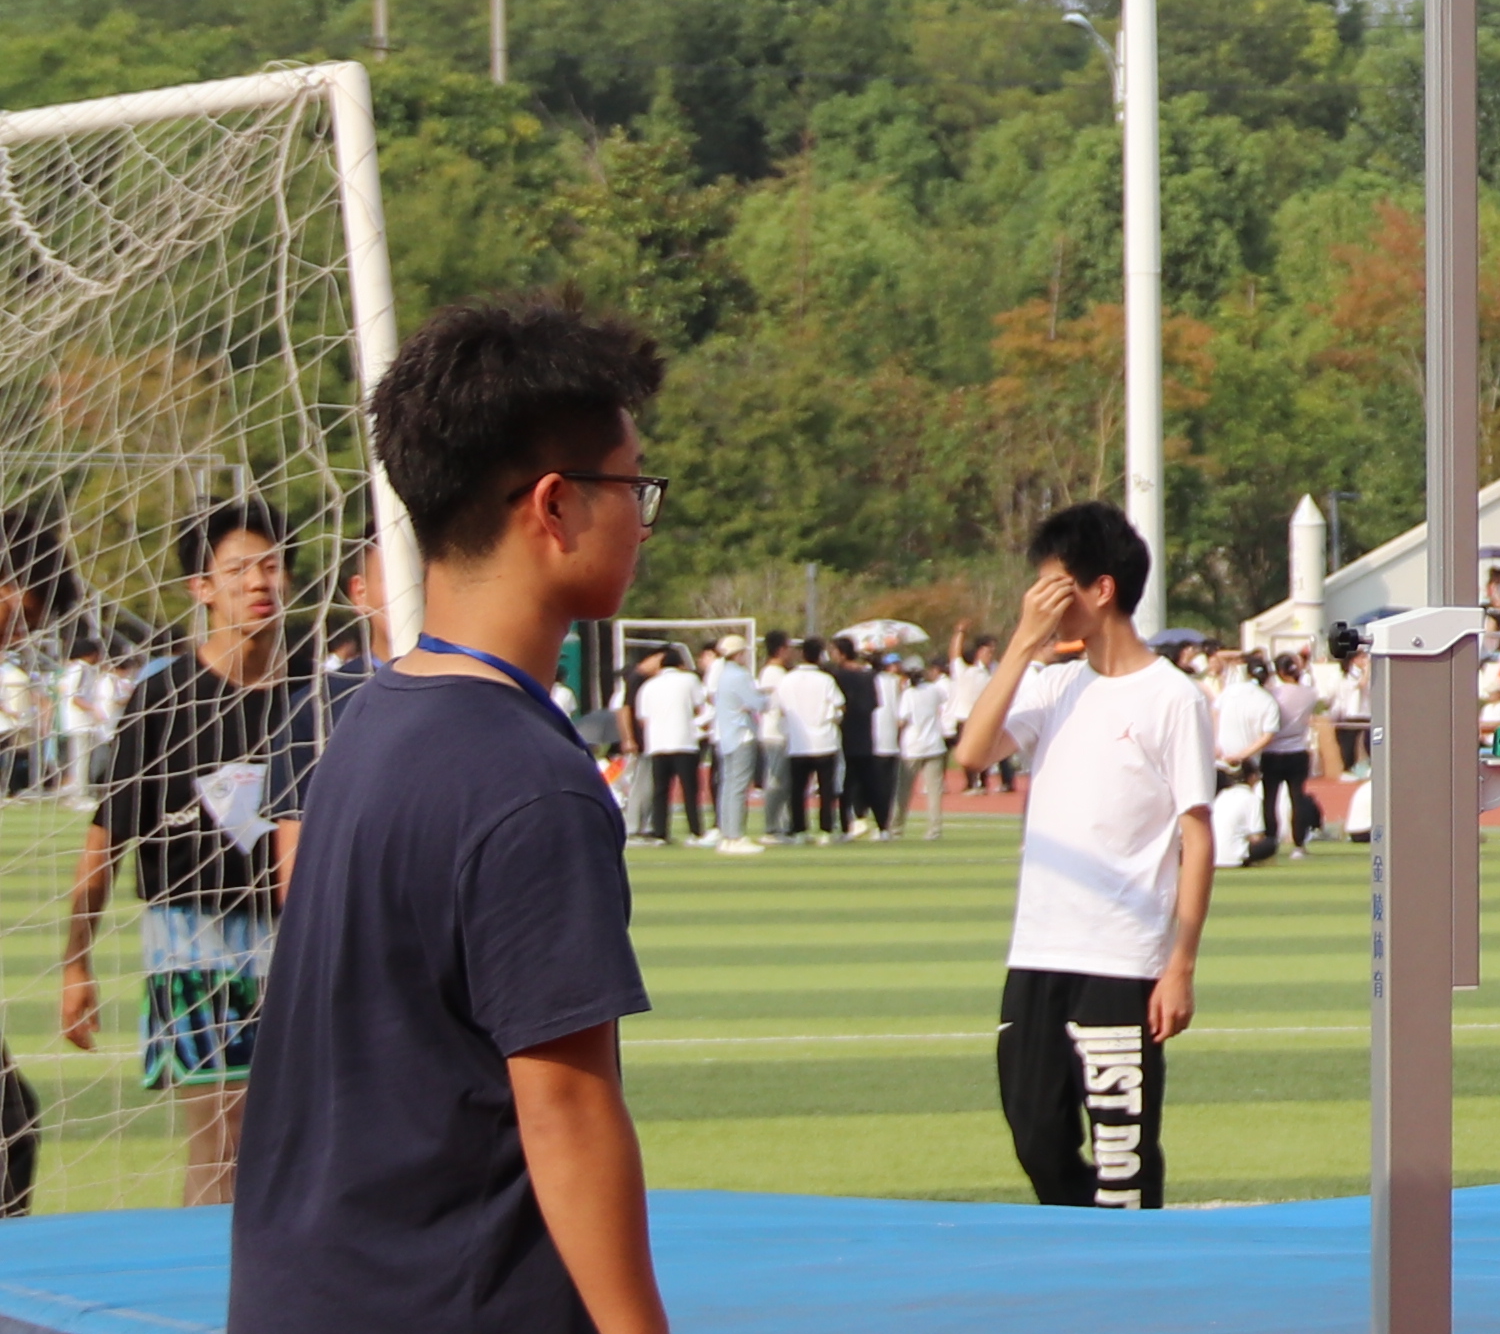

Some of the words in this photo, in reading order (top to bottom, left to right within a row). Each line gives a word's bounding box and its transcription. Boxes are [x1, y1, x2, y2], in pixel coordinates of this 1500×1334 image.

[1373, 855, 1384, 999] 金陵体育
[1066, 1021, 1143, 1116] JUST
[1094, 1123, 1142, 1182] DO
